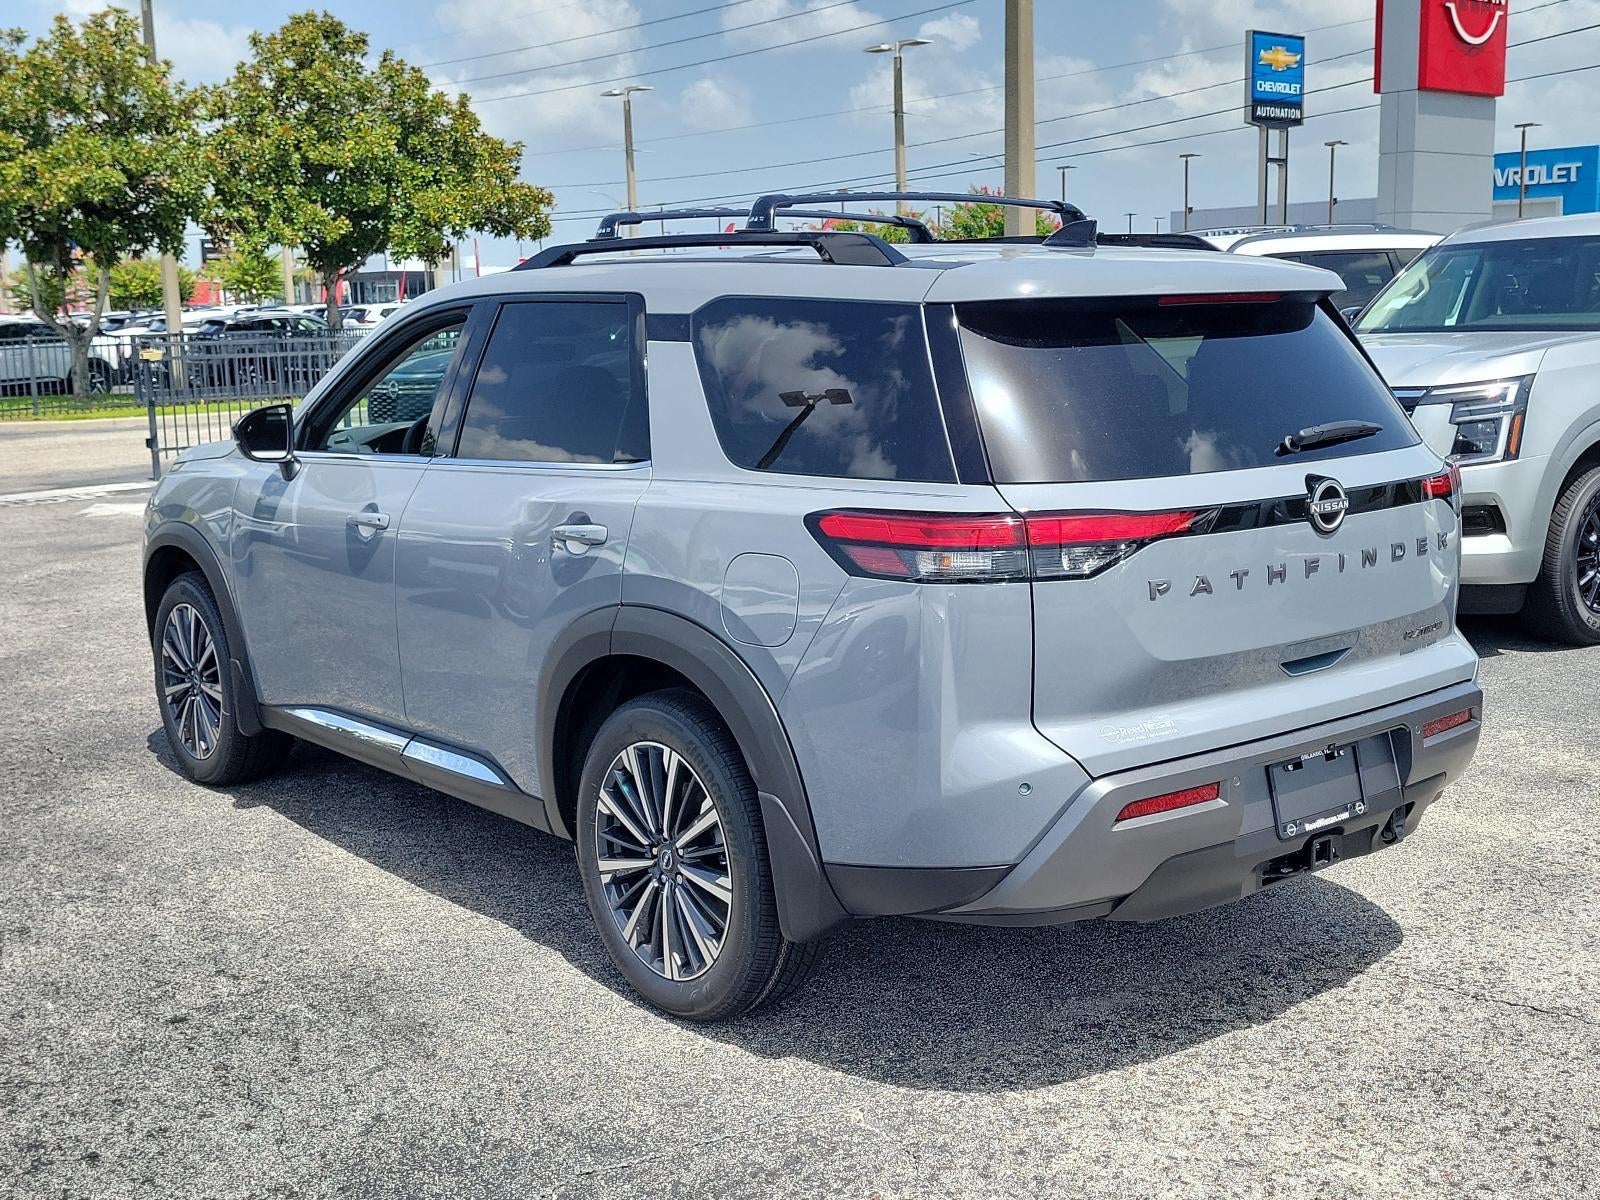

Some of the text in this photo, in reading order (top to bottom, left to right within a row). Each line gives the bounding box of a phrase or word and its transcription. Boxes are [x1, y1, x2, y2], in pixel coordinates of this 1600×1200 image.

[1256, 80, 1301, 94] CHEVROLET
[1256, 105, 1301, 119] AUTONATION
[1311, 499, 1349, 513] NISSAN
[1147, 530, 1449, 602] PATHFINDER
